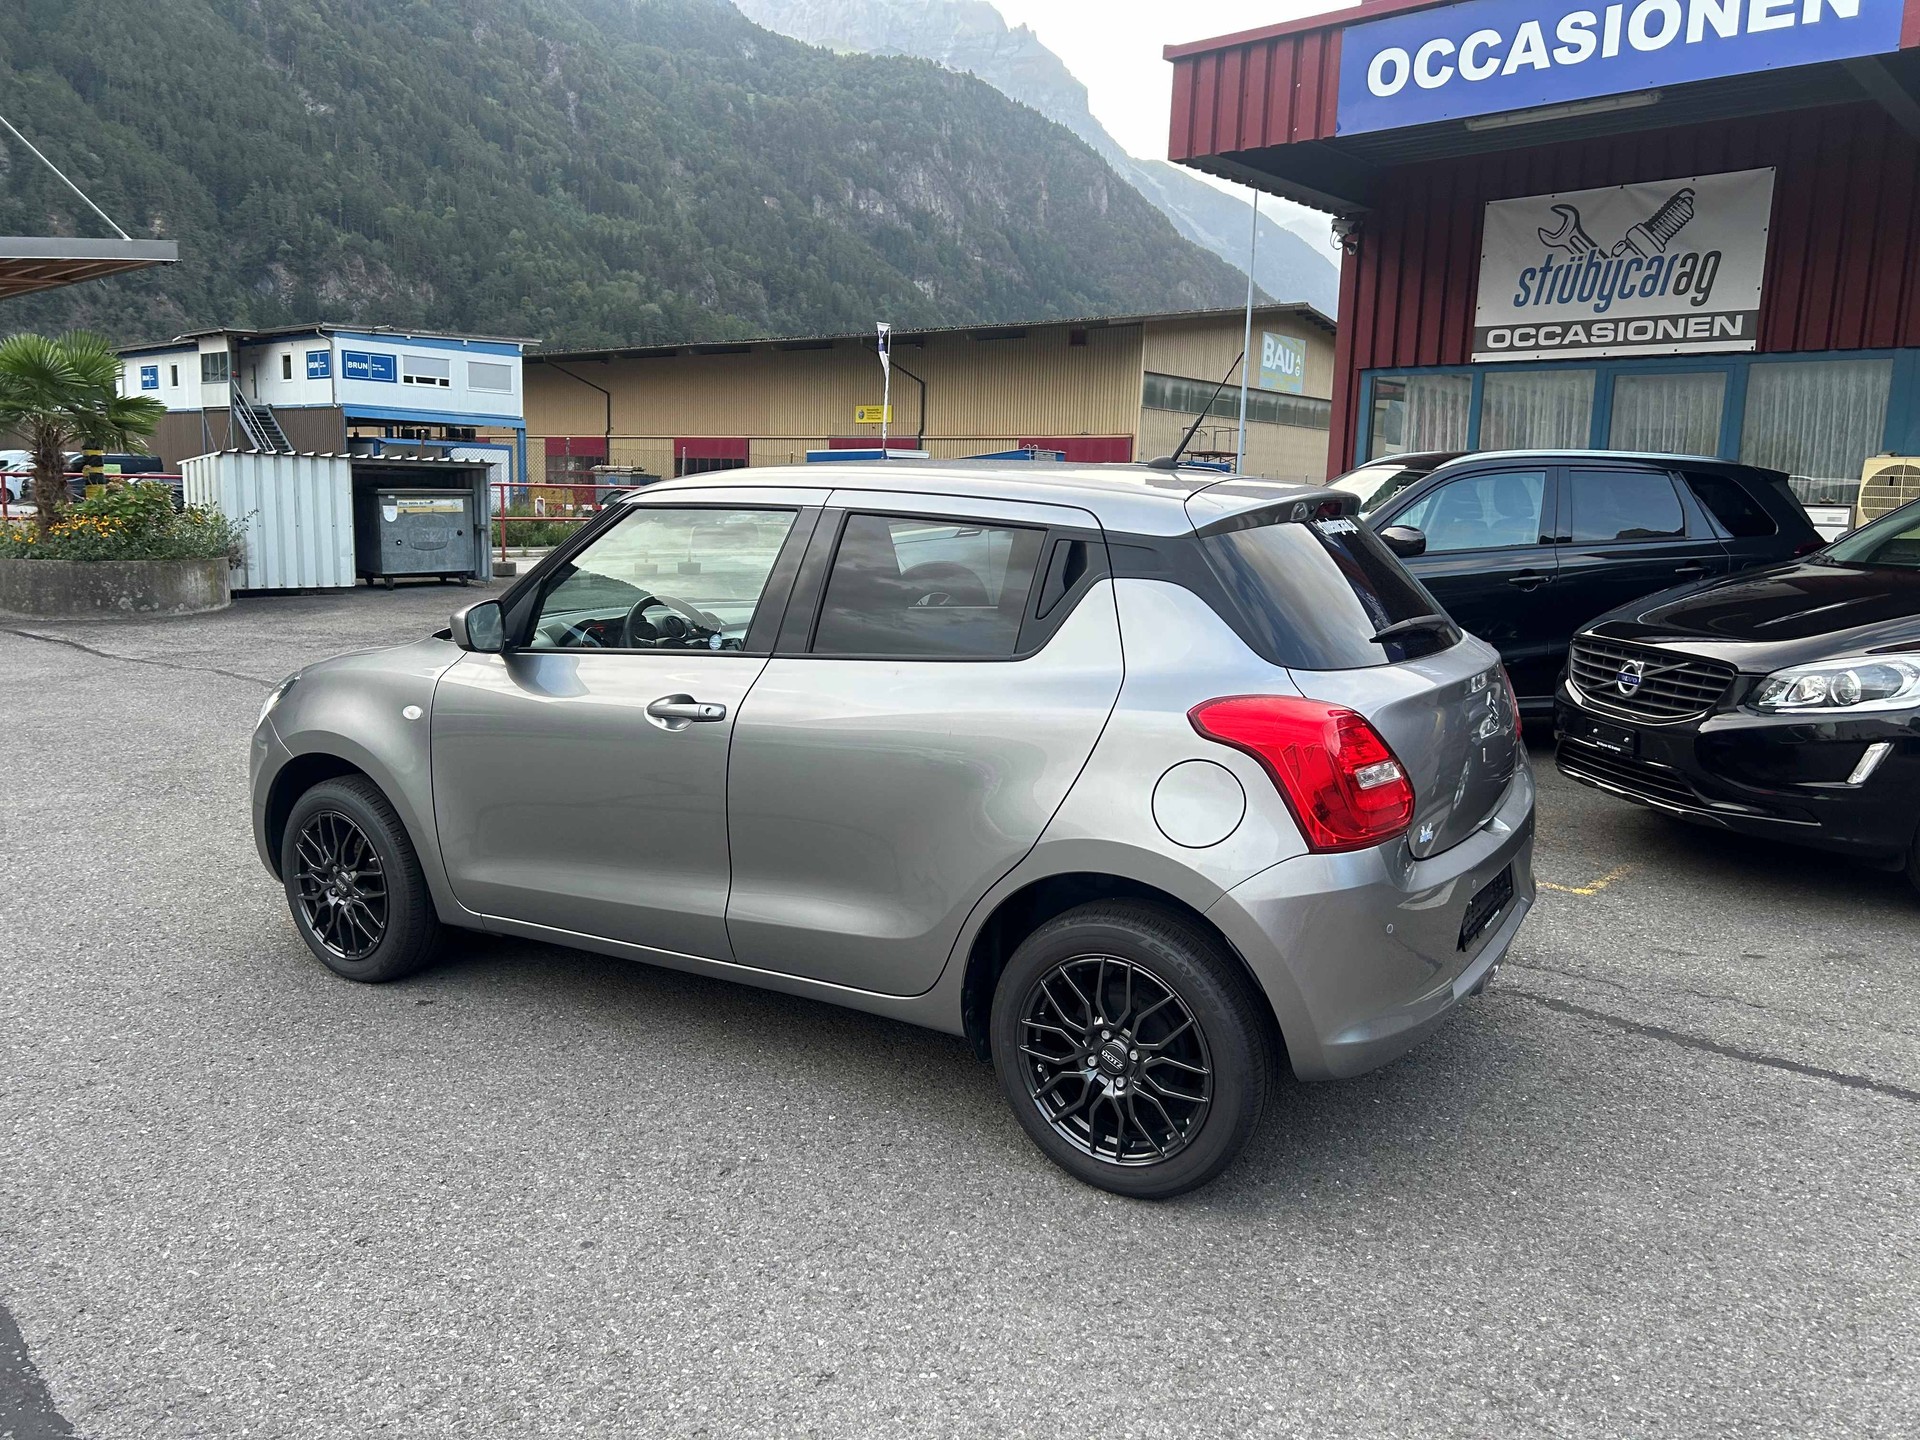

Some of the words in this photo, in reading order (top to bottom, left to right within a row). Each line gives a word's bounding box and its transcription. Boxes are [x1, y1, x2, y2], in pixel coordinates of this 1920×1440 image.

[1486, 314, 1743, 348] OCCASIONEN
[347, 361, 369, 370] BRUN
[1263, 335, 1294, 375] BAU
[1101, 1050, 1123, 1069] DOTZ
